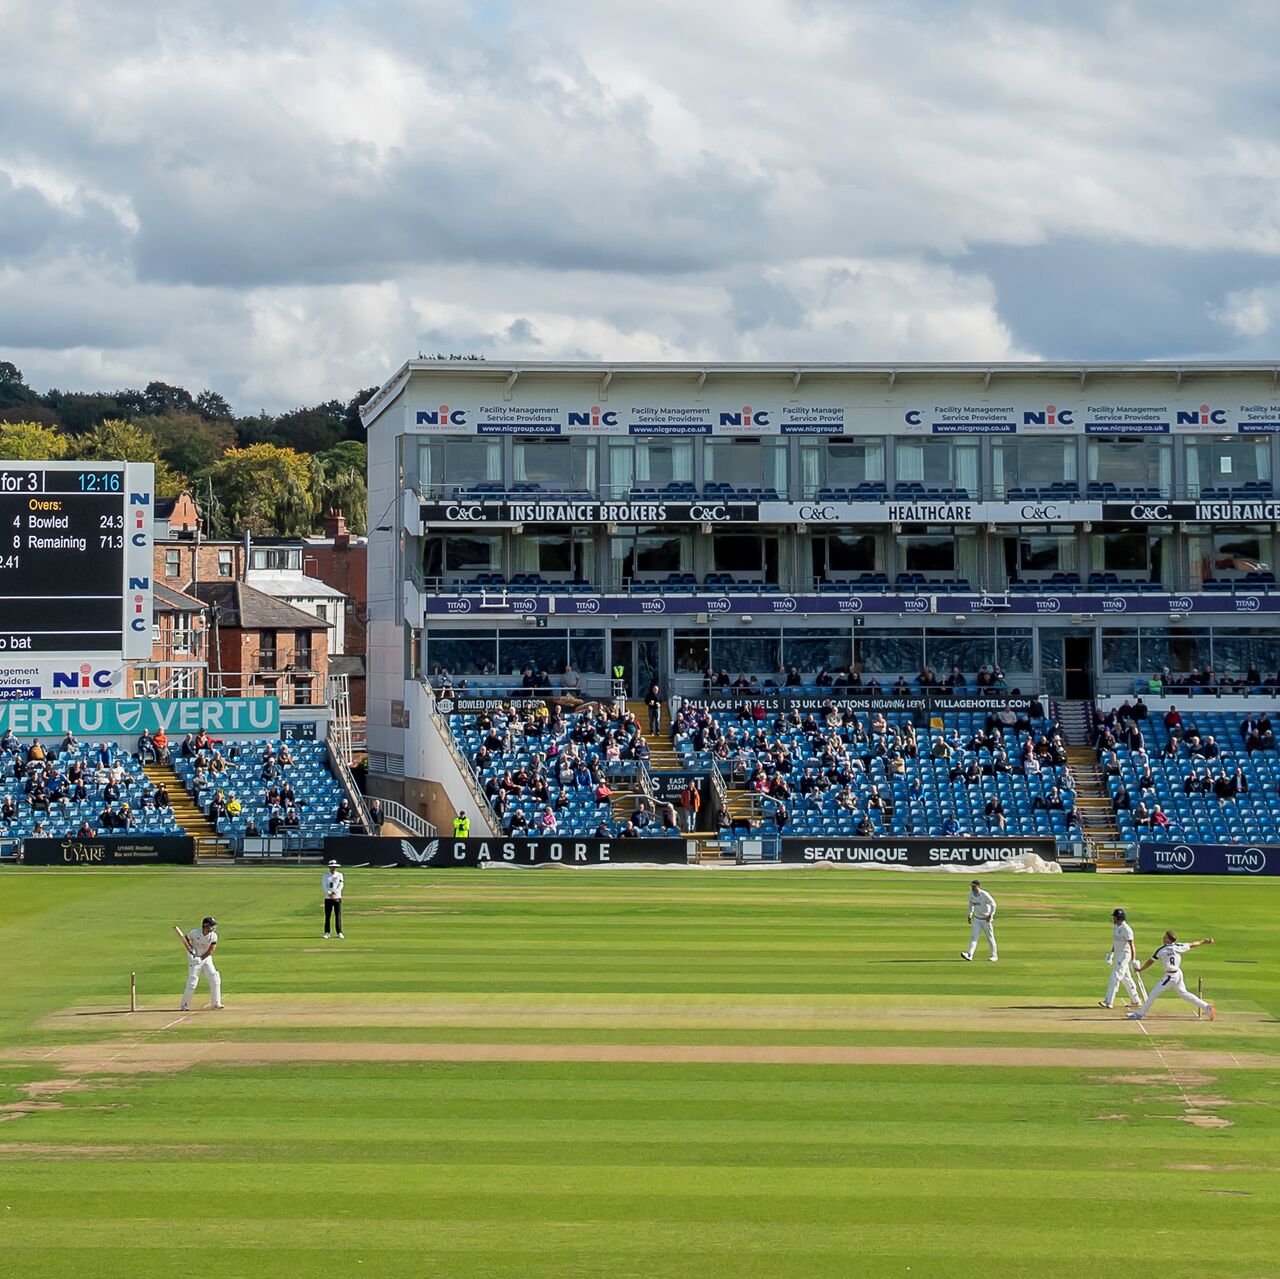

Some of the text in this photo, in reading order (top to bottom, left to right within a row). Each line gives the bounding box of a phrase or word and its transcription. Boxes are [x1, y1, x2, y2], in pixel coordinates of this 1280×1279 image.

[480, 406, 559, 418] Facility Management
[482, 424, 555, 434] www.nicgroup.co.uk
[1, 473, 23, 491] for
[27, 473, 38, 491] 3
[78, 474, 120, 491] 12:16
[29, 499, 61, 510] Overs:
[510, 505, 592, 521] INSURANCE
[600, 505, 666, 521] BROKERS
[888, 505, 972, 520] HEALTHCARE
[1195, 504, 1280, 520] INSURANCE
[13, 515, 20, 528] 4
[29, 515, 123, 528] Bowled 24.3
[13, 535, 20, 548] 8
[29, 535, 123, 551] Remaining 71.3
[10, 635, 31, 649] bat
[934, 699, 1031, 708] VILLAGEHOTELSCOM
[150, 700, 274, 729] VERTU
[454, 843, 610, 861] CASTORE
[804, 848, 908, 862] SEAT UNIQUE
[929, 848, 970, 861] SEAT
[1154, 851, 1186, 862] TITAN
[1225, 854, 1257, 865] TITAN
